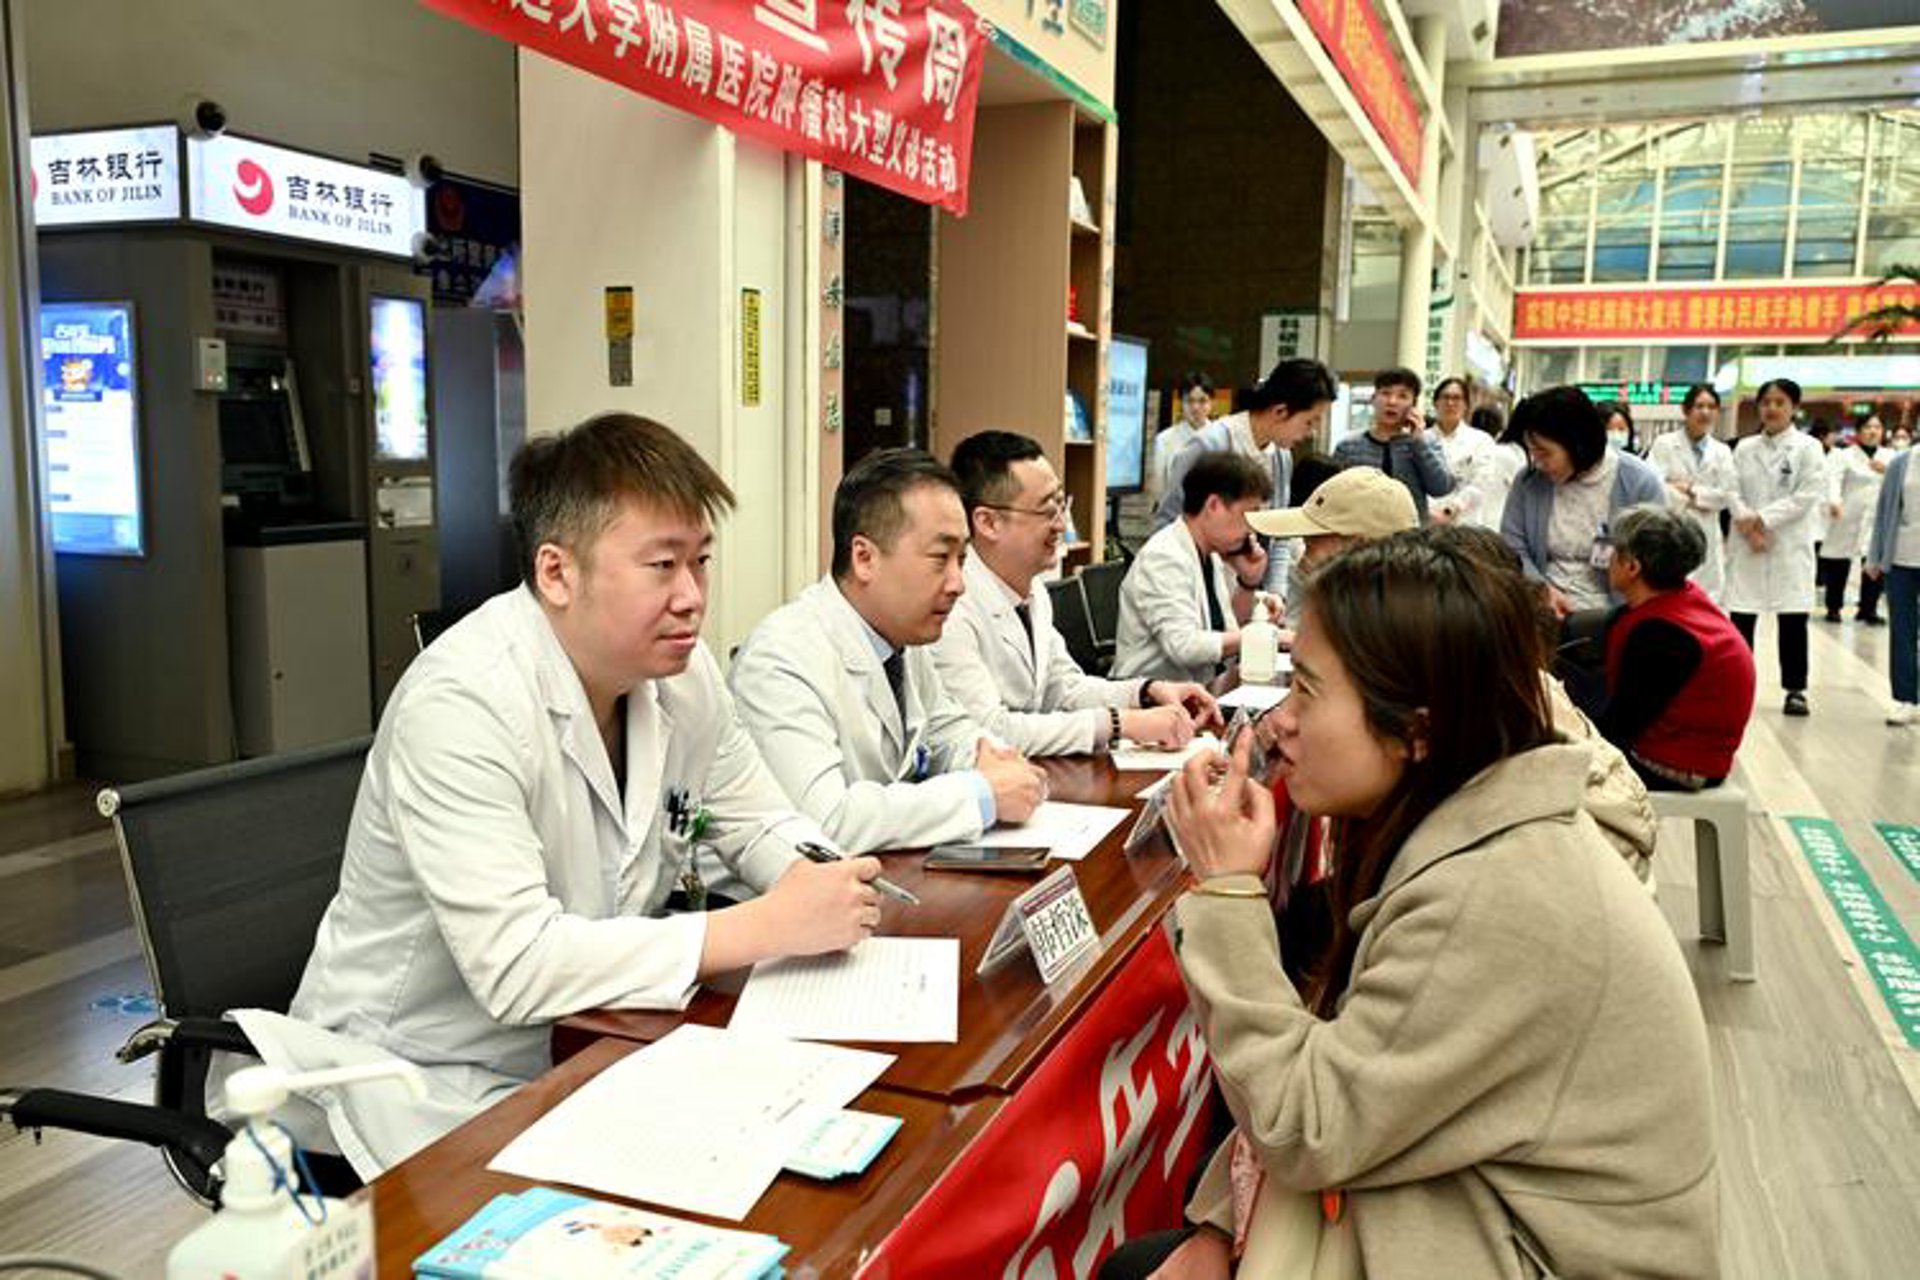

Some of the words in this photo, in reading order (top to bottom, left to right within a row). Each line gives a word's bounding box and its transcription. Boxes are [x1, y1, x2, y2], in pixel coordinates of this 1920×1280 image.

[47, 151, 164, 186] 吉林银行
[51, 189, 93, 206] BANK
[97, 187, 116, 203] OF
[122, 184, 163, 202] JILIN
[286, 175, 394, 217] 吉林银行
[288, 204, 331, 227] BANK
[334, 213, 353, 228] OF
[357, 217, 393, 236] JILIN
